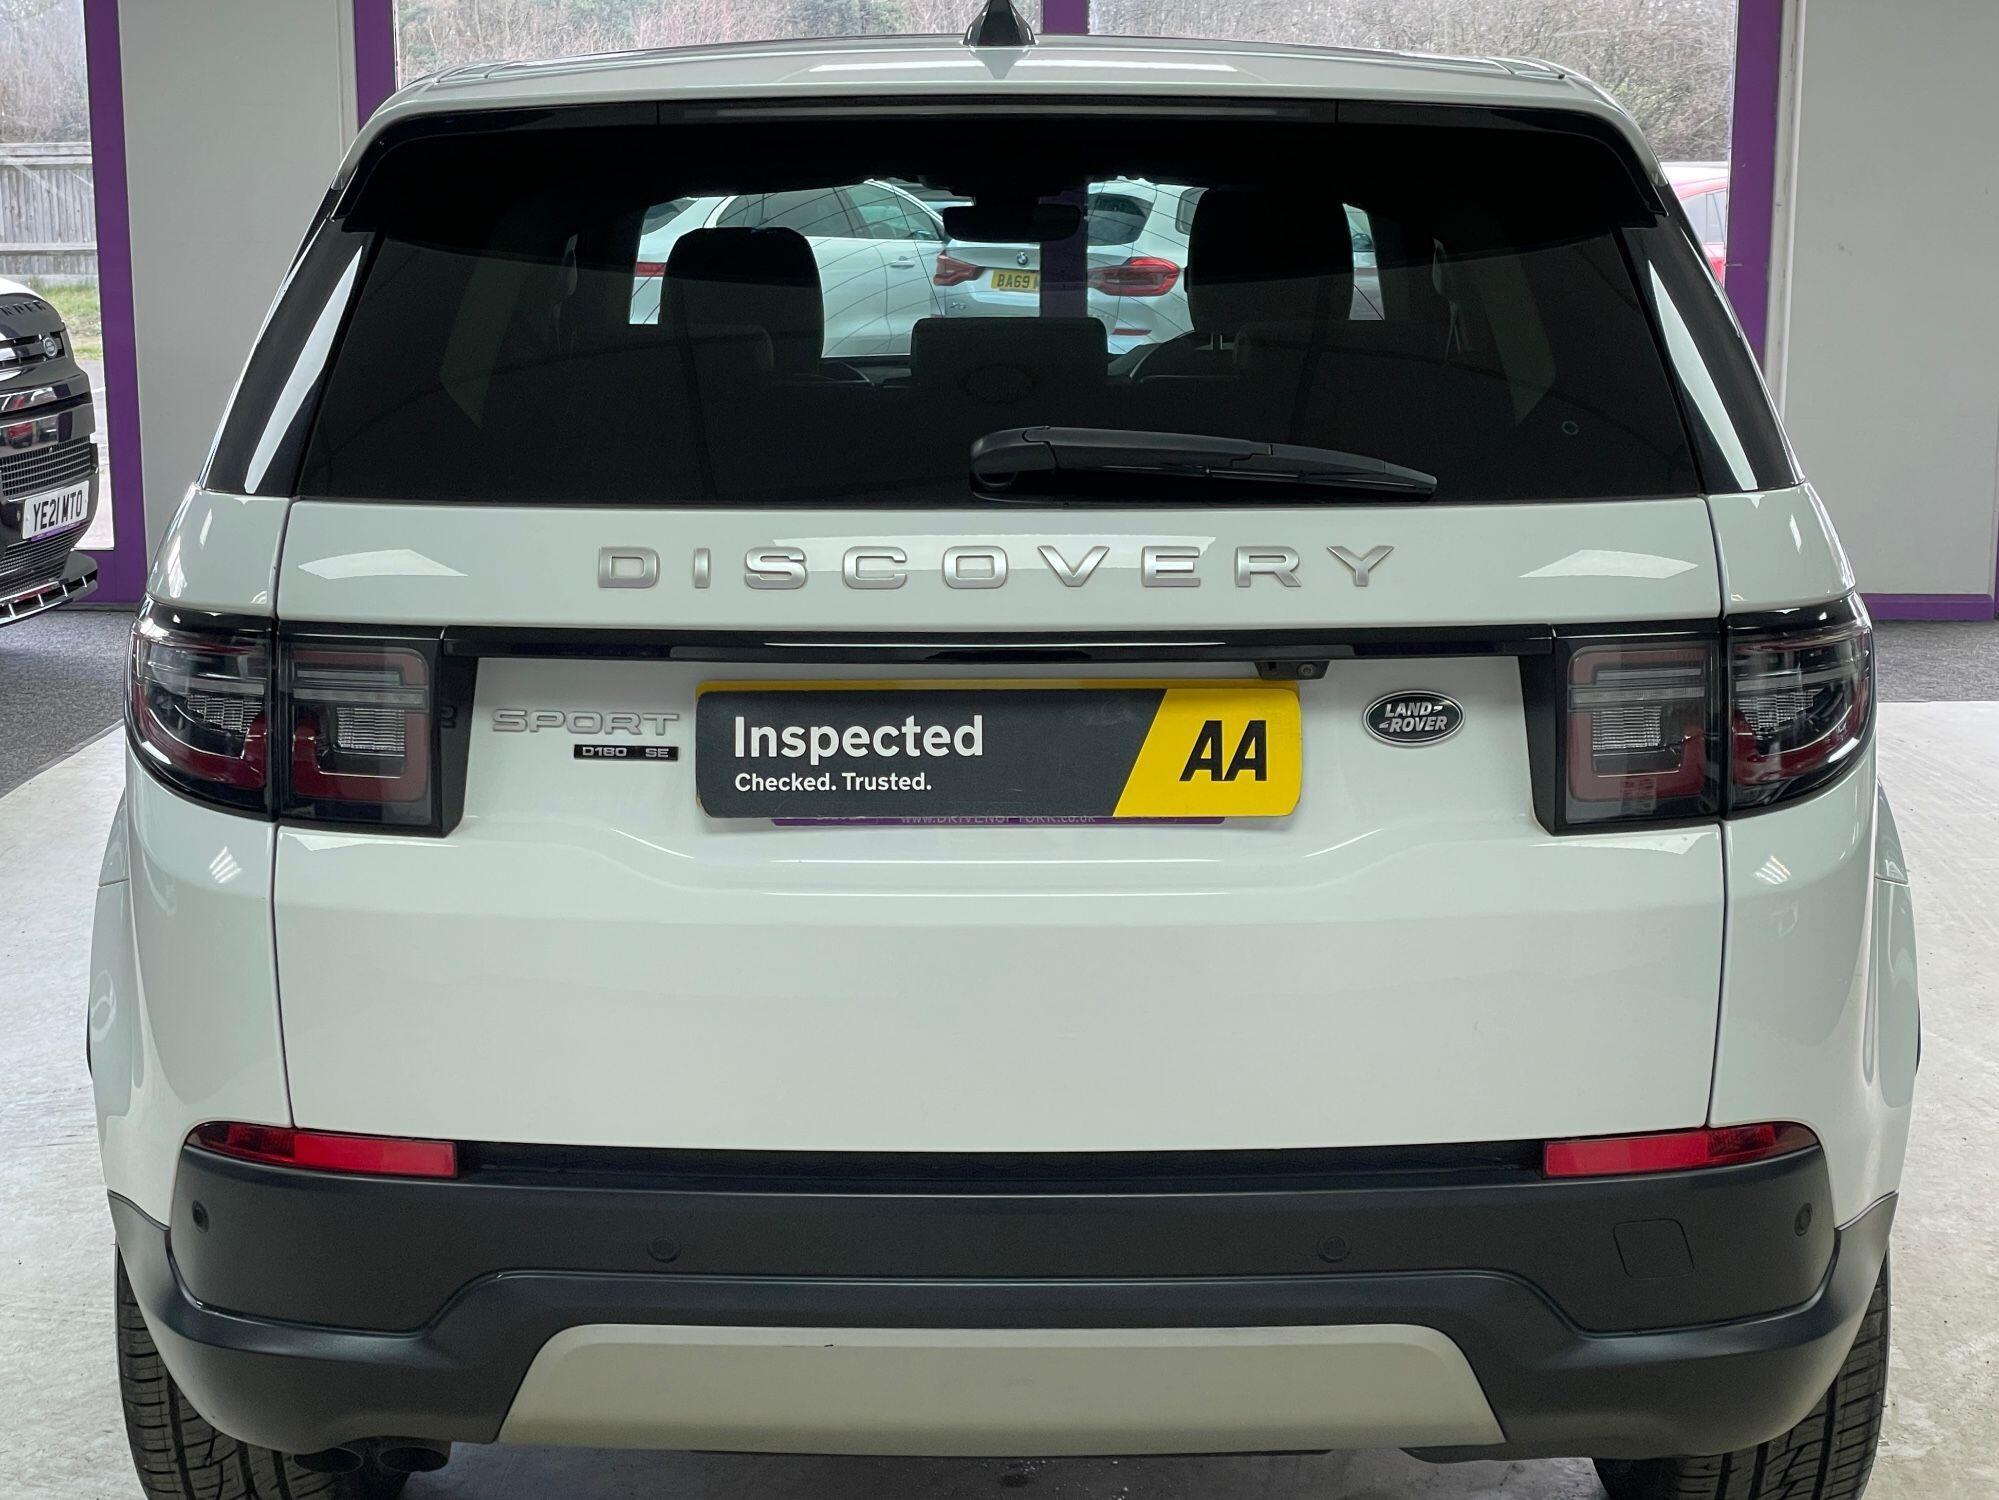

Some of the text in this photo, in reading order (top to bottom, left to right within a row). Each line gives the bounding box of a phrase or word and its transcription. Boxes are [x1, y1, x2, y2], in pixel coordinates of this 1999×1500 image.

[997, 273, 1030, 288] BA69
[33, 497, 60, 532] YE21
[61, 490, 83, 523] MTO
[598, 545, 1395, 590] DISCOVERY
[1384, 702, 1433, 718] LAND
[493, 709, 680, 736] SPORT
[1389, 716, 1448, 733] ROVER
[734, 714, 984, 766] Inspected
[1178, 720, 1268, 782] AA
[582, 747, 670, 758] D180 SE
[734, 772, 933, 792] Checked. Trusted.
